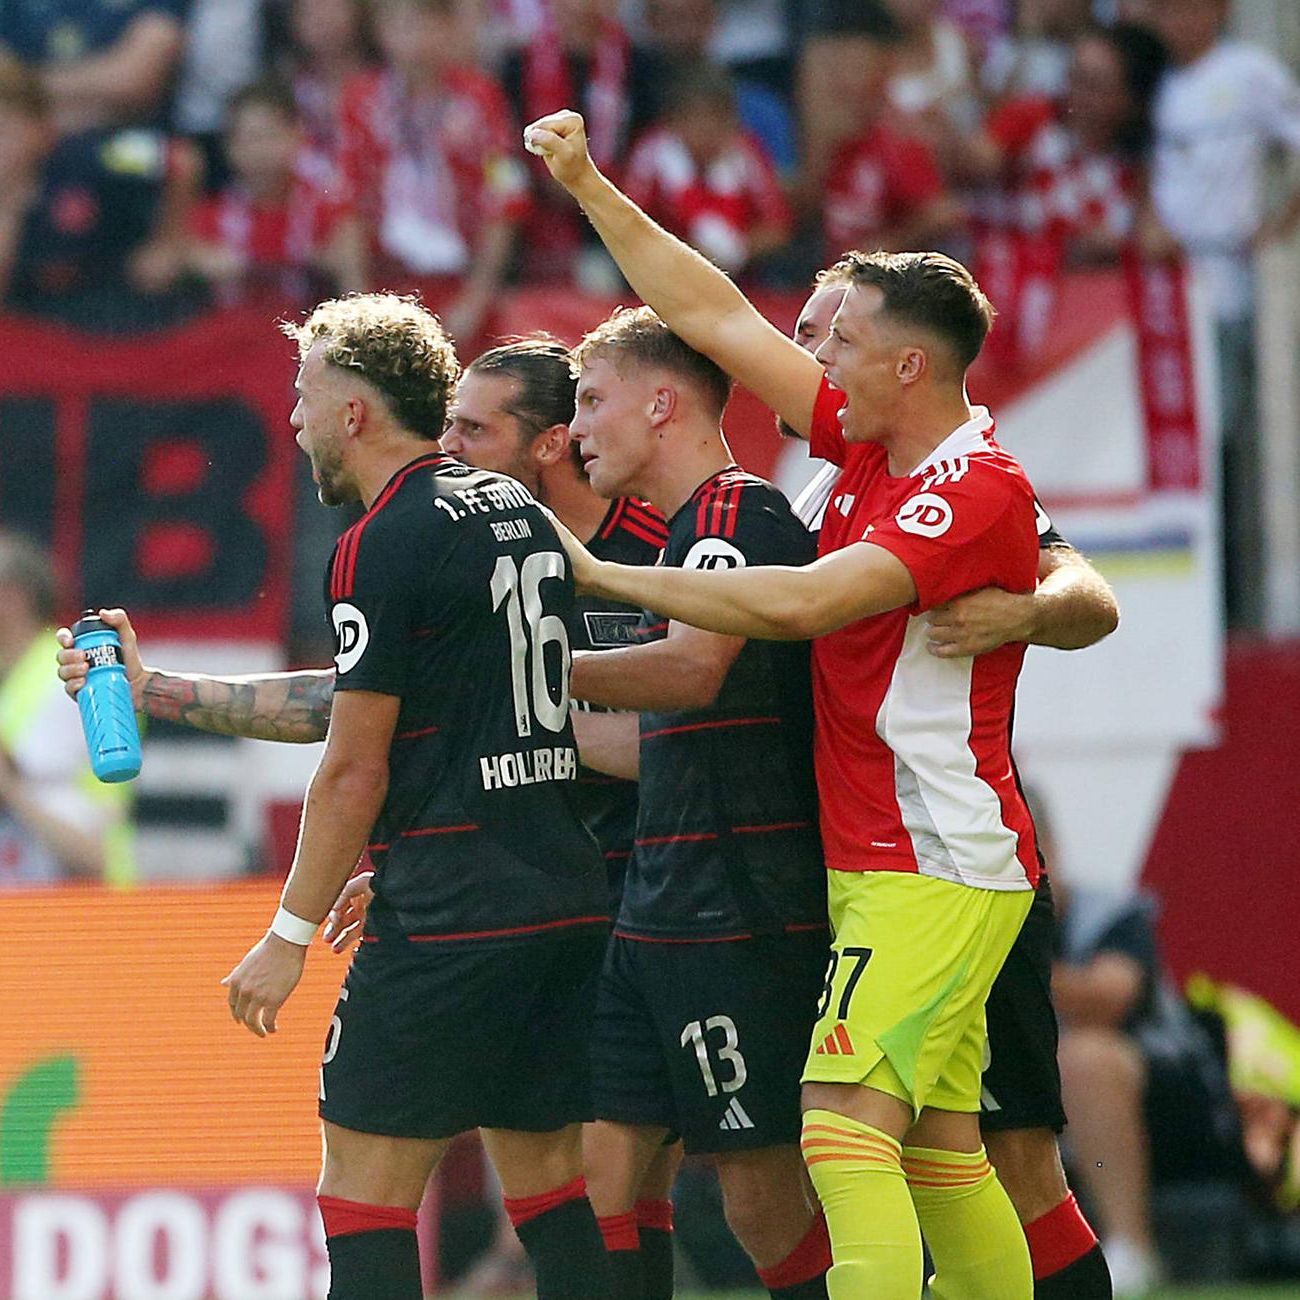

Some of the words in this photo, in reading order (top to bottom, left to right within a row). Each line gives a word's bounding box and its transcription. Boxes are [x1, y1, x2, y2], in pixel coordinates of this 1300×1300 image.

[434, 497, 466, 521] 1.
[453, 488, 490, 514] FC
[490, 519, 531, 541] BERLIN
[490, 552, 571, 737] 16
[680, 1015, 747, 1097] 13
